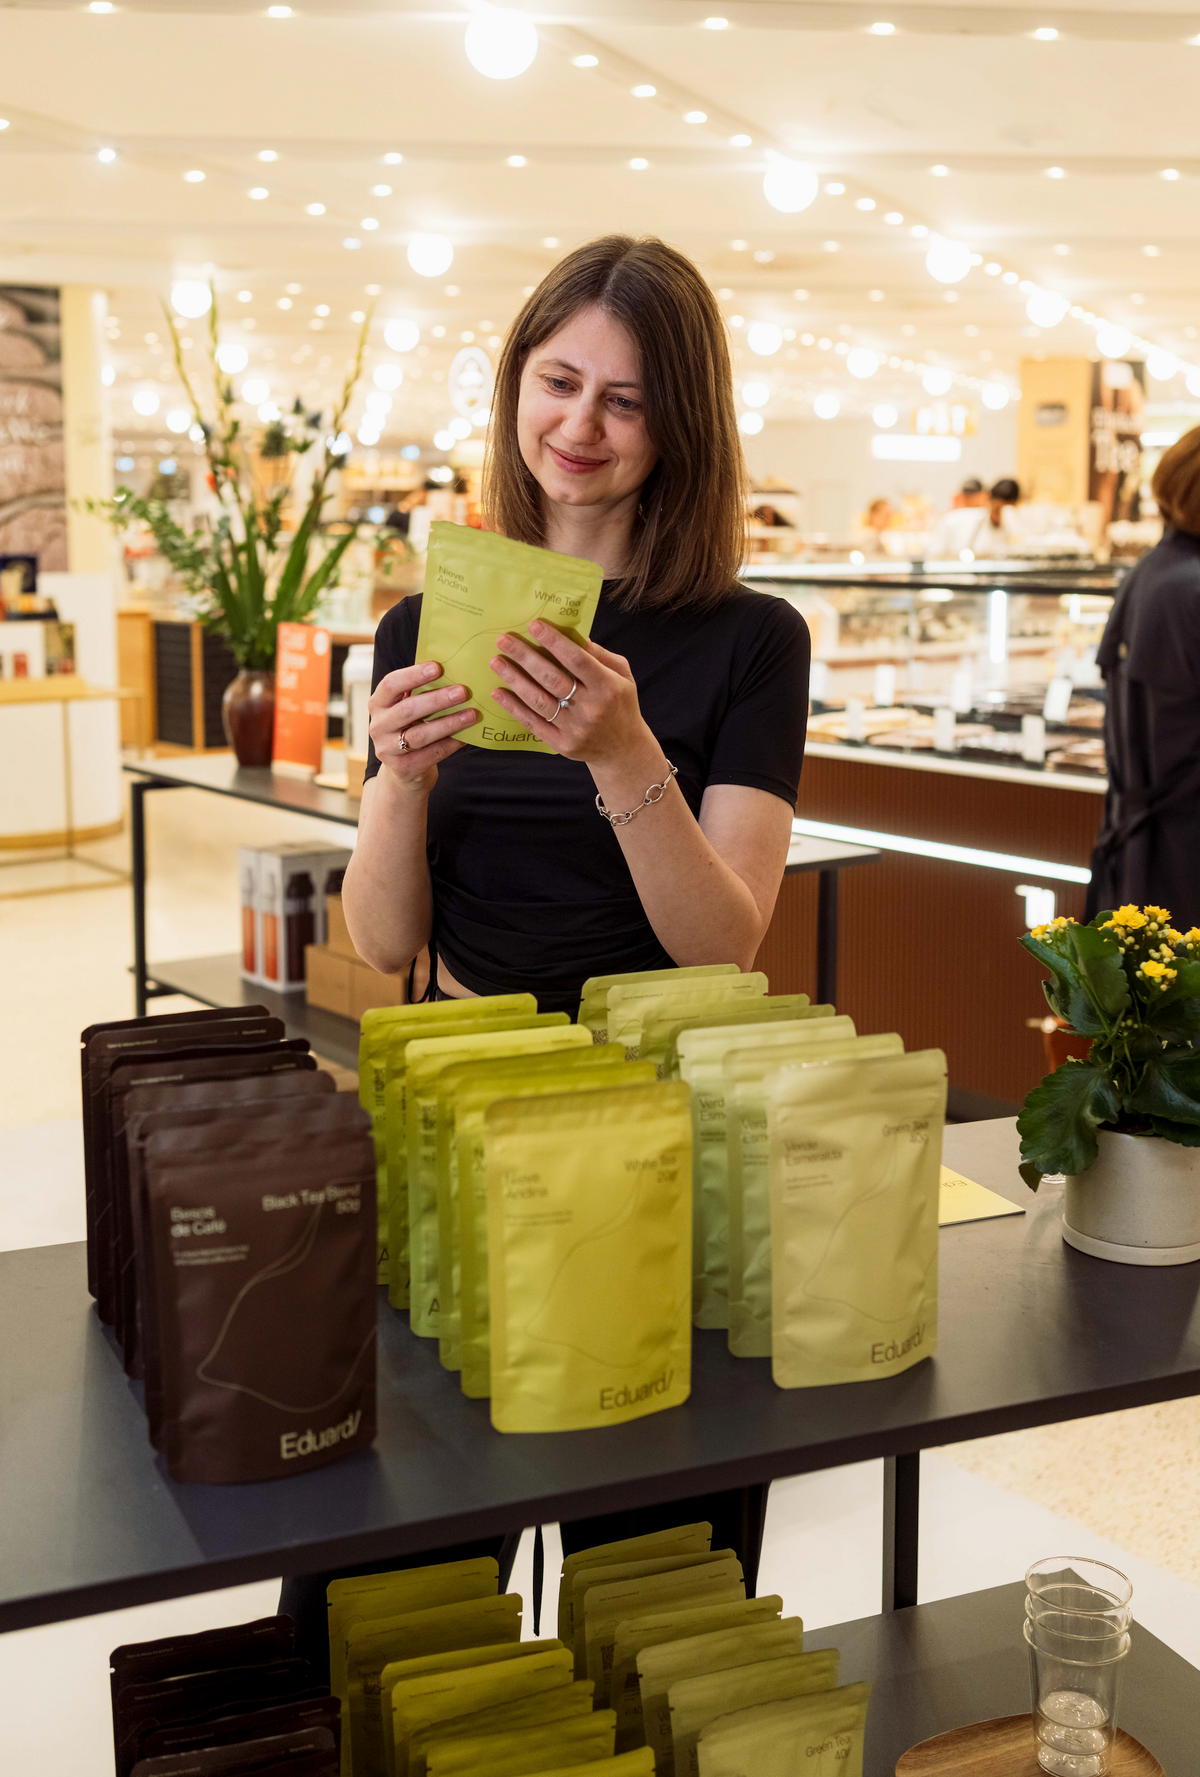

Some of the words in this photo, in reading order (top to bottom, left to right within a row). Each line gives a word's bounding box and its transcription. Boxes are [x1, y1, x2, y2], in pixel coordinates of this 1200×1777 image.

[438, 565, 465, 581] Nieve
[436, 575, 468, 593] Andina
[534, 590, 562, 605] White
[565, 596, 581, 606] Tea
[559, 607, 579, 617] 20g
[699, 1095, 725, 1109] Verd
[262, 1193, 299, 1212] Black
[300, 1188, 326, 1205] Tea
[170, 1223, 192, 1238] de
[805, 1741, 833, 1758] Green
[833, 1735, 852, 1747] Tea
